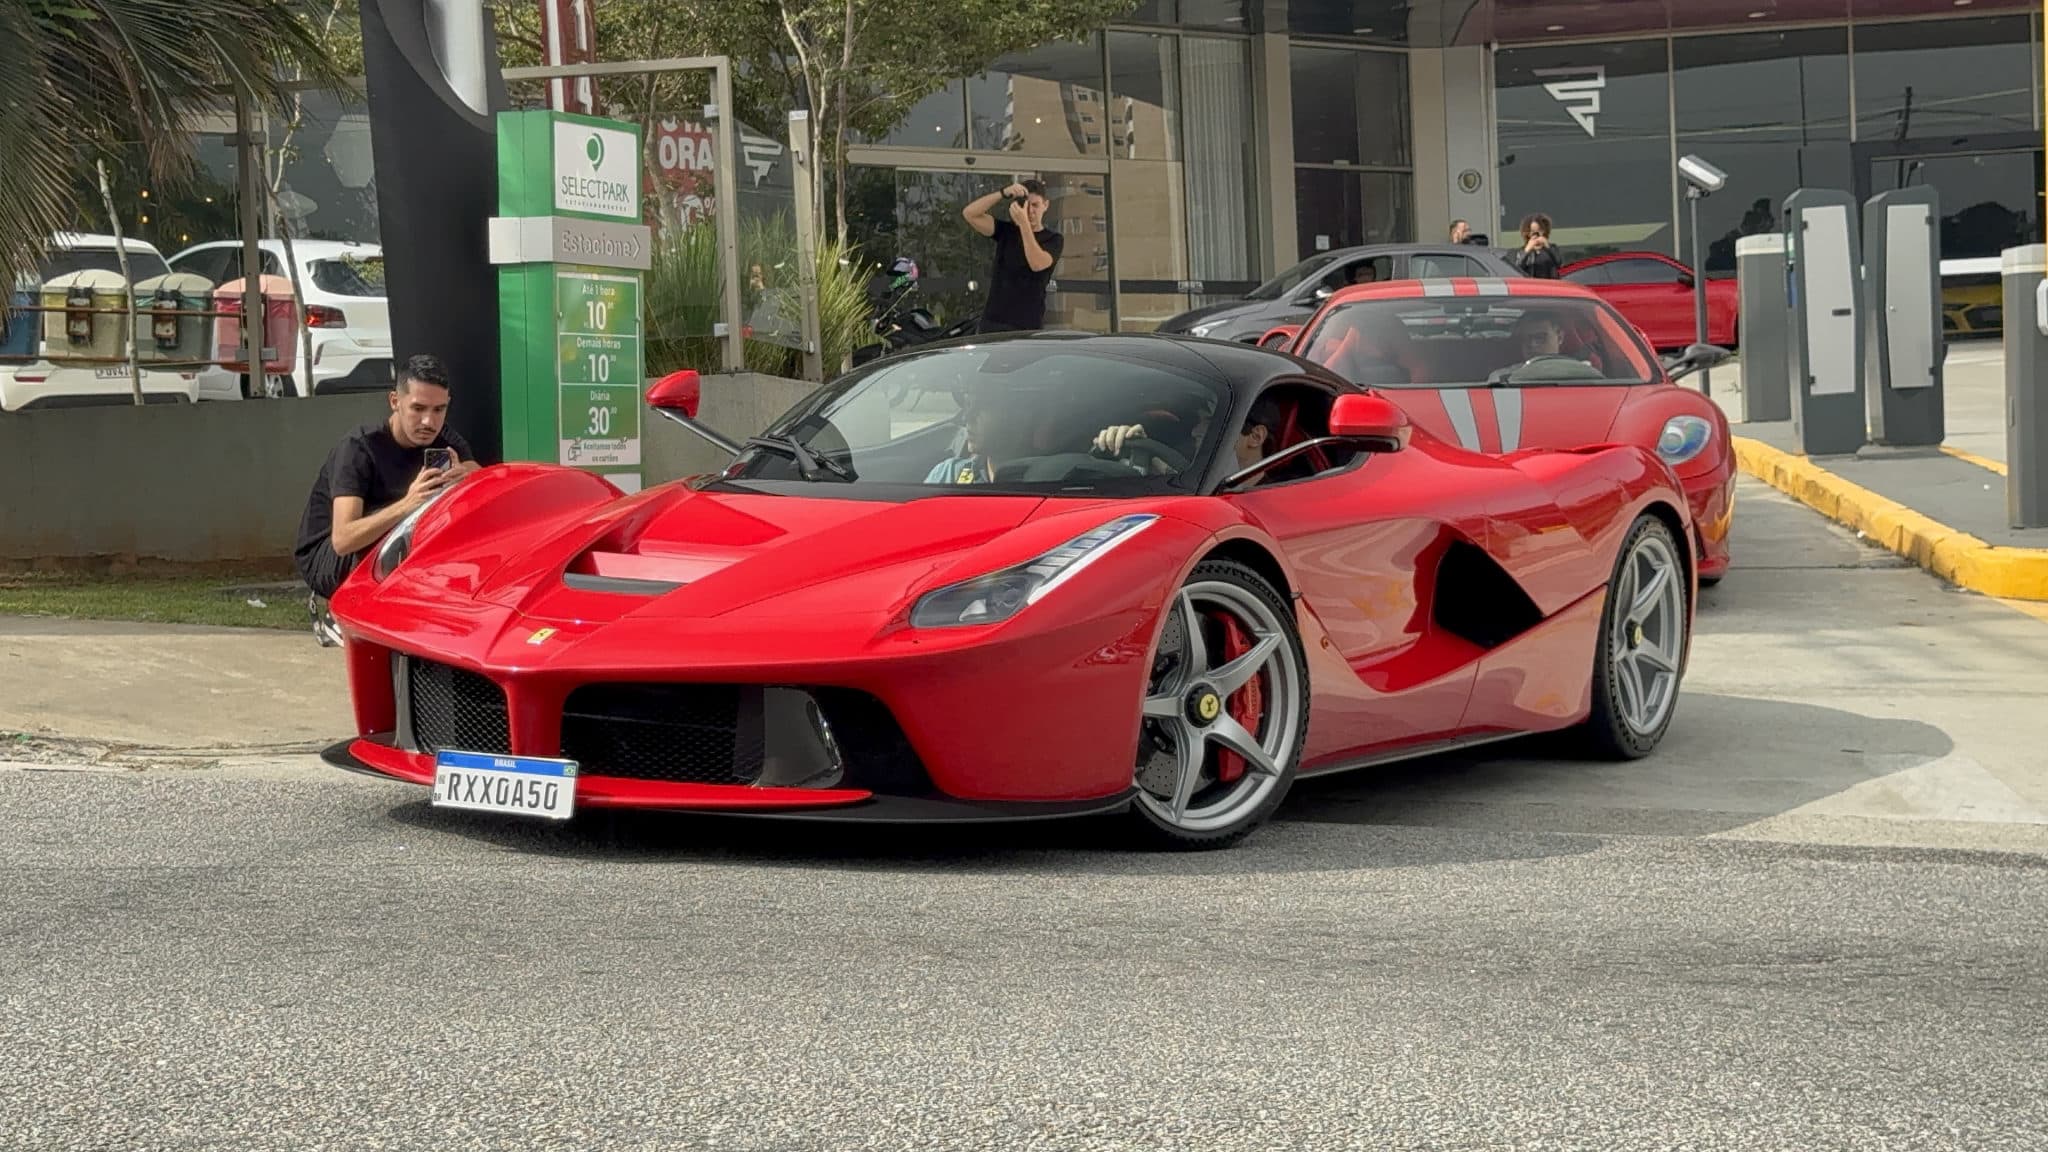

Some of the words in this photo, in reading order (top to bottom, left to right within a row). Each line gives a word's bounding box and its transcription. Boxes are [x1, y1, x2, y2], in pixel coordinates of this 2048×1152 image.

[561, 175, 630, 203] SELECTPARK
[562, 230, 632, 257] Estacione
[586, 301, 607, 330] 10
[576, 336, 601, 349] Demais
[603, 338, 621, 350] horas
[588, 353, 609, 382] 10
[590, 390, 610, 401] Diária
[588, 406, 610, 436] 30
[494, 758, 517, 769] BRASIL
[447, 772, 559, 811] RXX0A50
